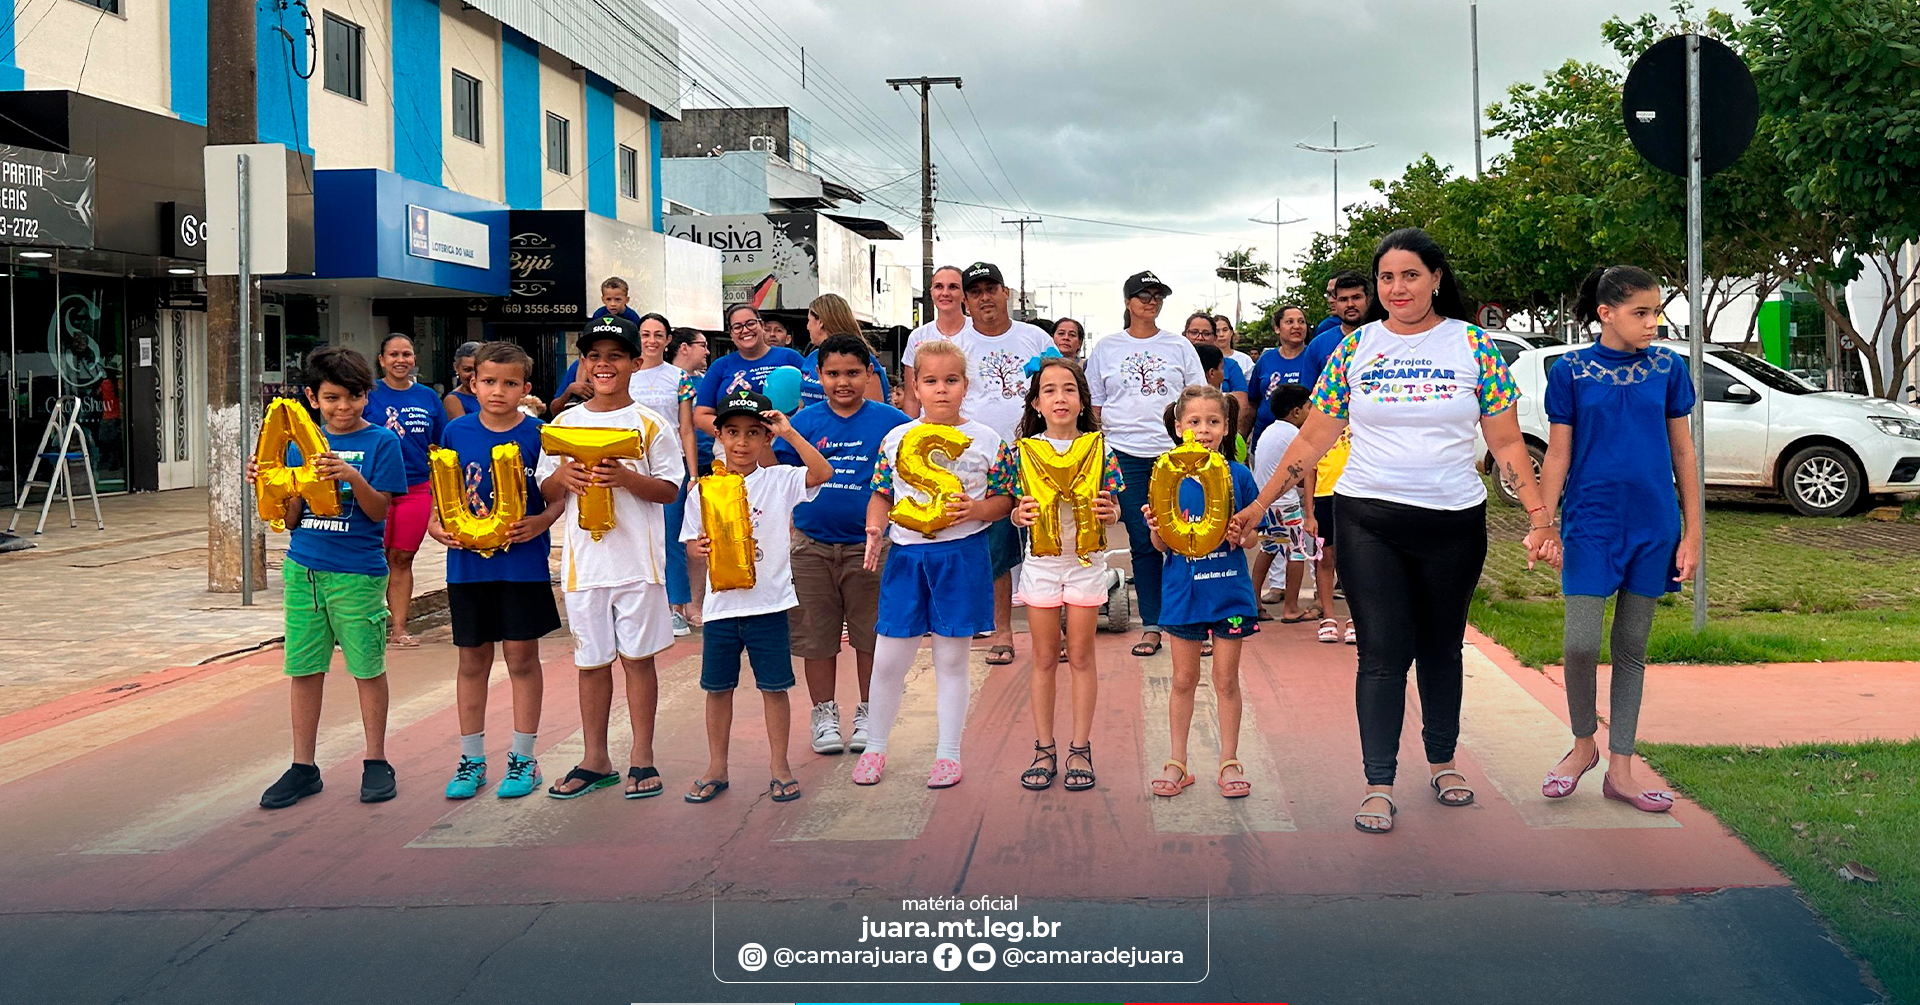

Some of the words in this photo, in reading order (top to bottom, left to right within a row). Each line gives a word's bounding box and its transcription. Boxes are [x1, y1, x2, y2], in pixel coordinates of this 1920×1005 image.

[2, 161, 43, 187] PARTIR
[0, 188, 28, 211] EAIS
[502, 304, 522, 314] (66)
[524, 304, 578, 314] 3556-5569
[1486, 310, 1497, 327] E
[593, 325, 622, 334] SICOOB
[1393, 358, 1433, 367] Projeto
[1361, 368, 1456, 381] ENCANTAR
[1380, 383, 1458, 395] AUTISMO
[728, 399, 759, 408] SICOOB
